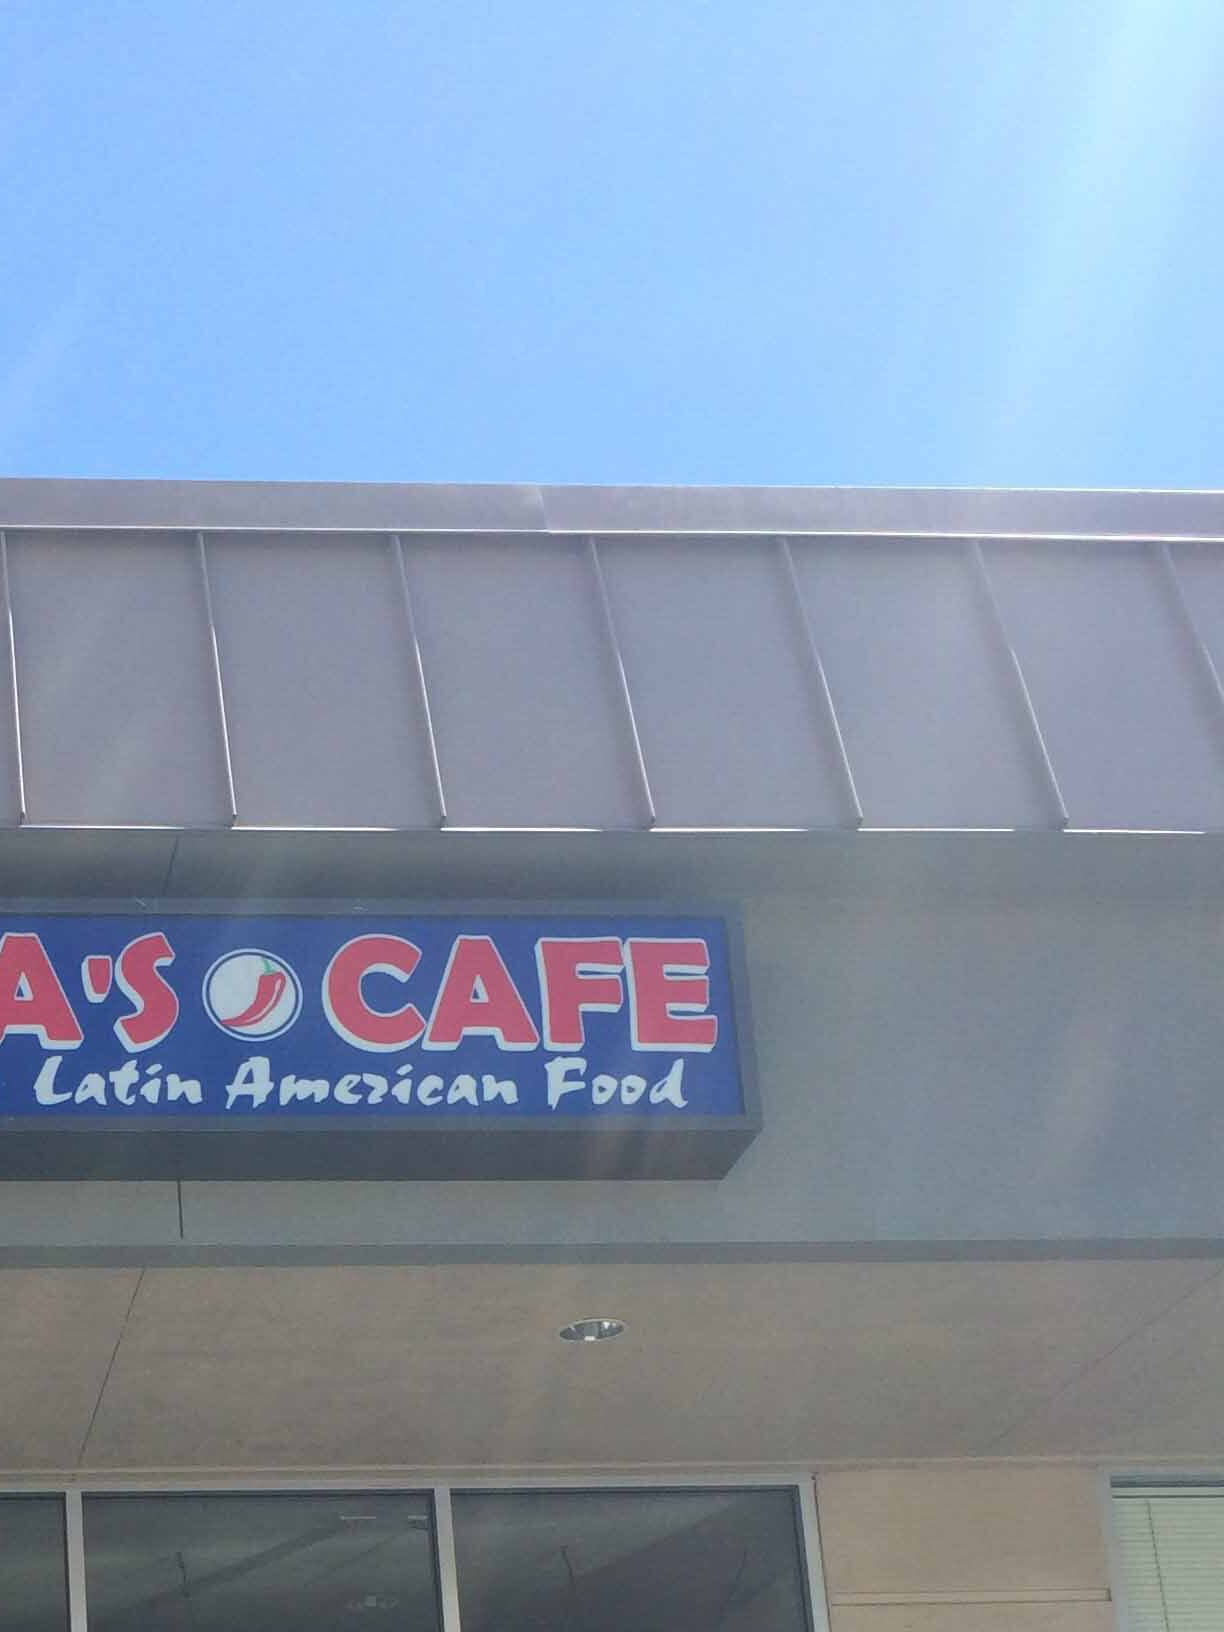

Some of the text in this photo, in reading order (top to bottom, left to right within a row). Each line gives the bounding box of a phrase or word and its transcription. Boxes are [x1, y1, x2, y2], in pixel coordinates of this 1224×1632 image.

[322, 933, 718, 1052] CAFE
[33, 1055, 202, 1106] Latin
[225, 1056, 519, 1109] American
[544, 1056, 688, 1109] Food
